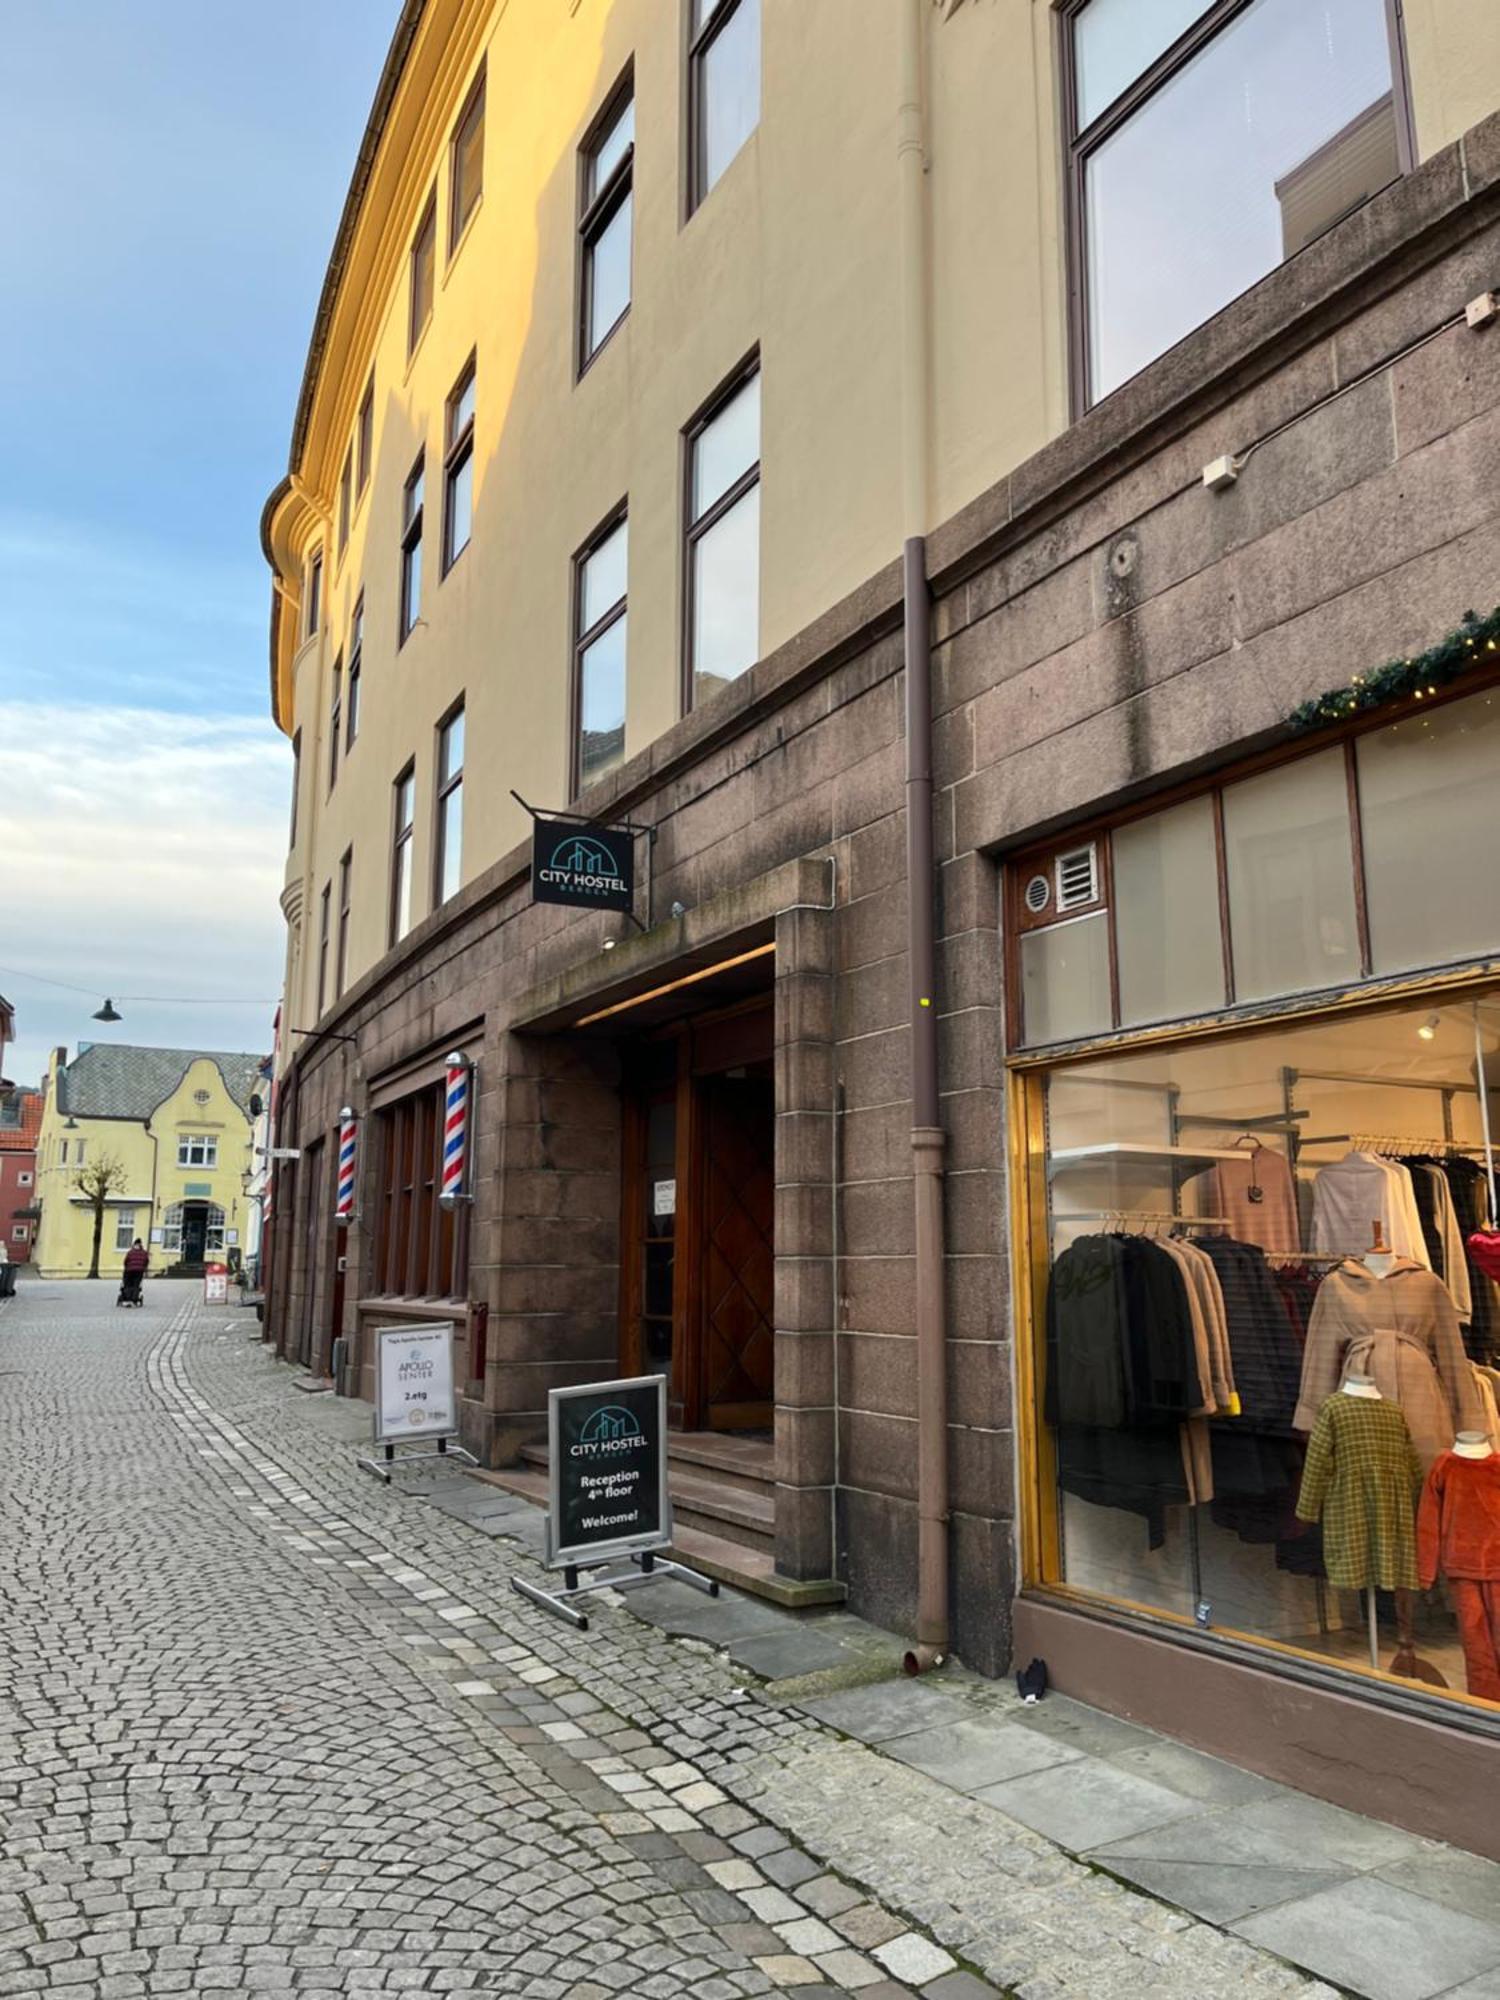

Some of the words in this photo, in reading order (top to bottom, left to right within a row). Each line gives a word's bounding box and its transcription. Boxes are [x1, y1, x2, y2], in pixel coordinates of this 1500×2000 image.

[539, 869, 571, 884] CITY
[574, 875, 628, 892] HOSTEL
[399, 1360, 434, 1373] APOLLO
[570, 1442, 599, 1457] CITY
[601, 1435, 648, 1452] HOSTEL
[580, 1470, 640, 1488] Reception
[587, 1489, 603, 1500] 4th
[605, 1485, 634, 1499] floor
[581, 1509, 639, 1529] Welcome!
